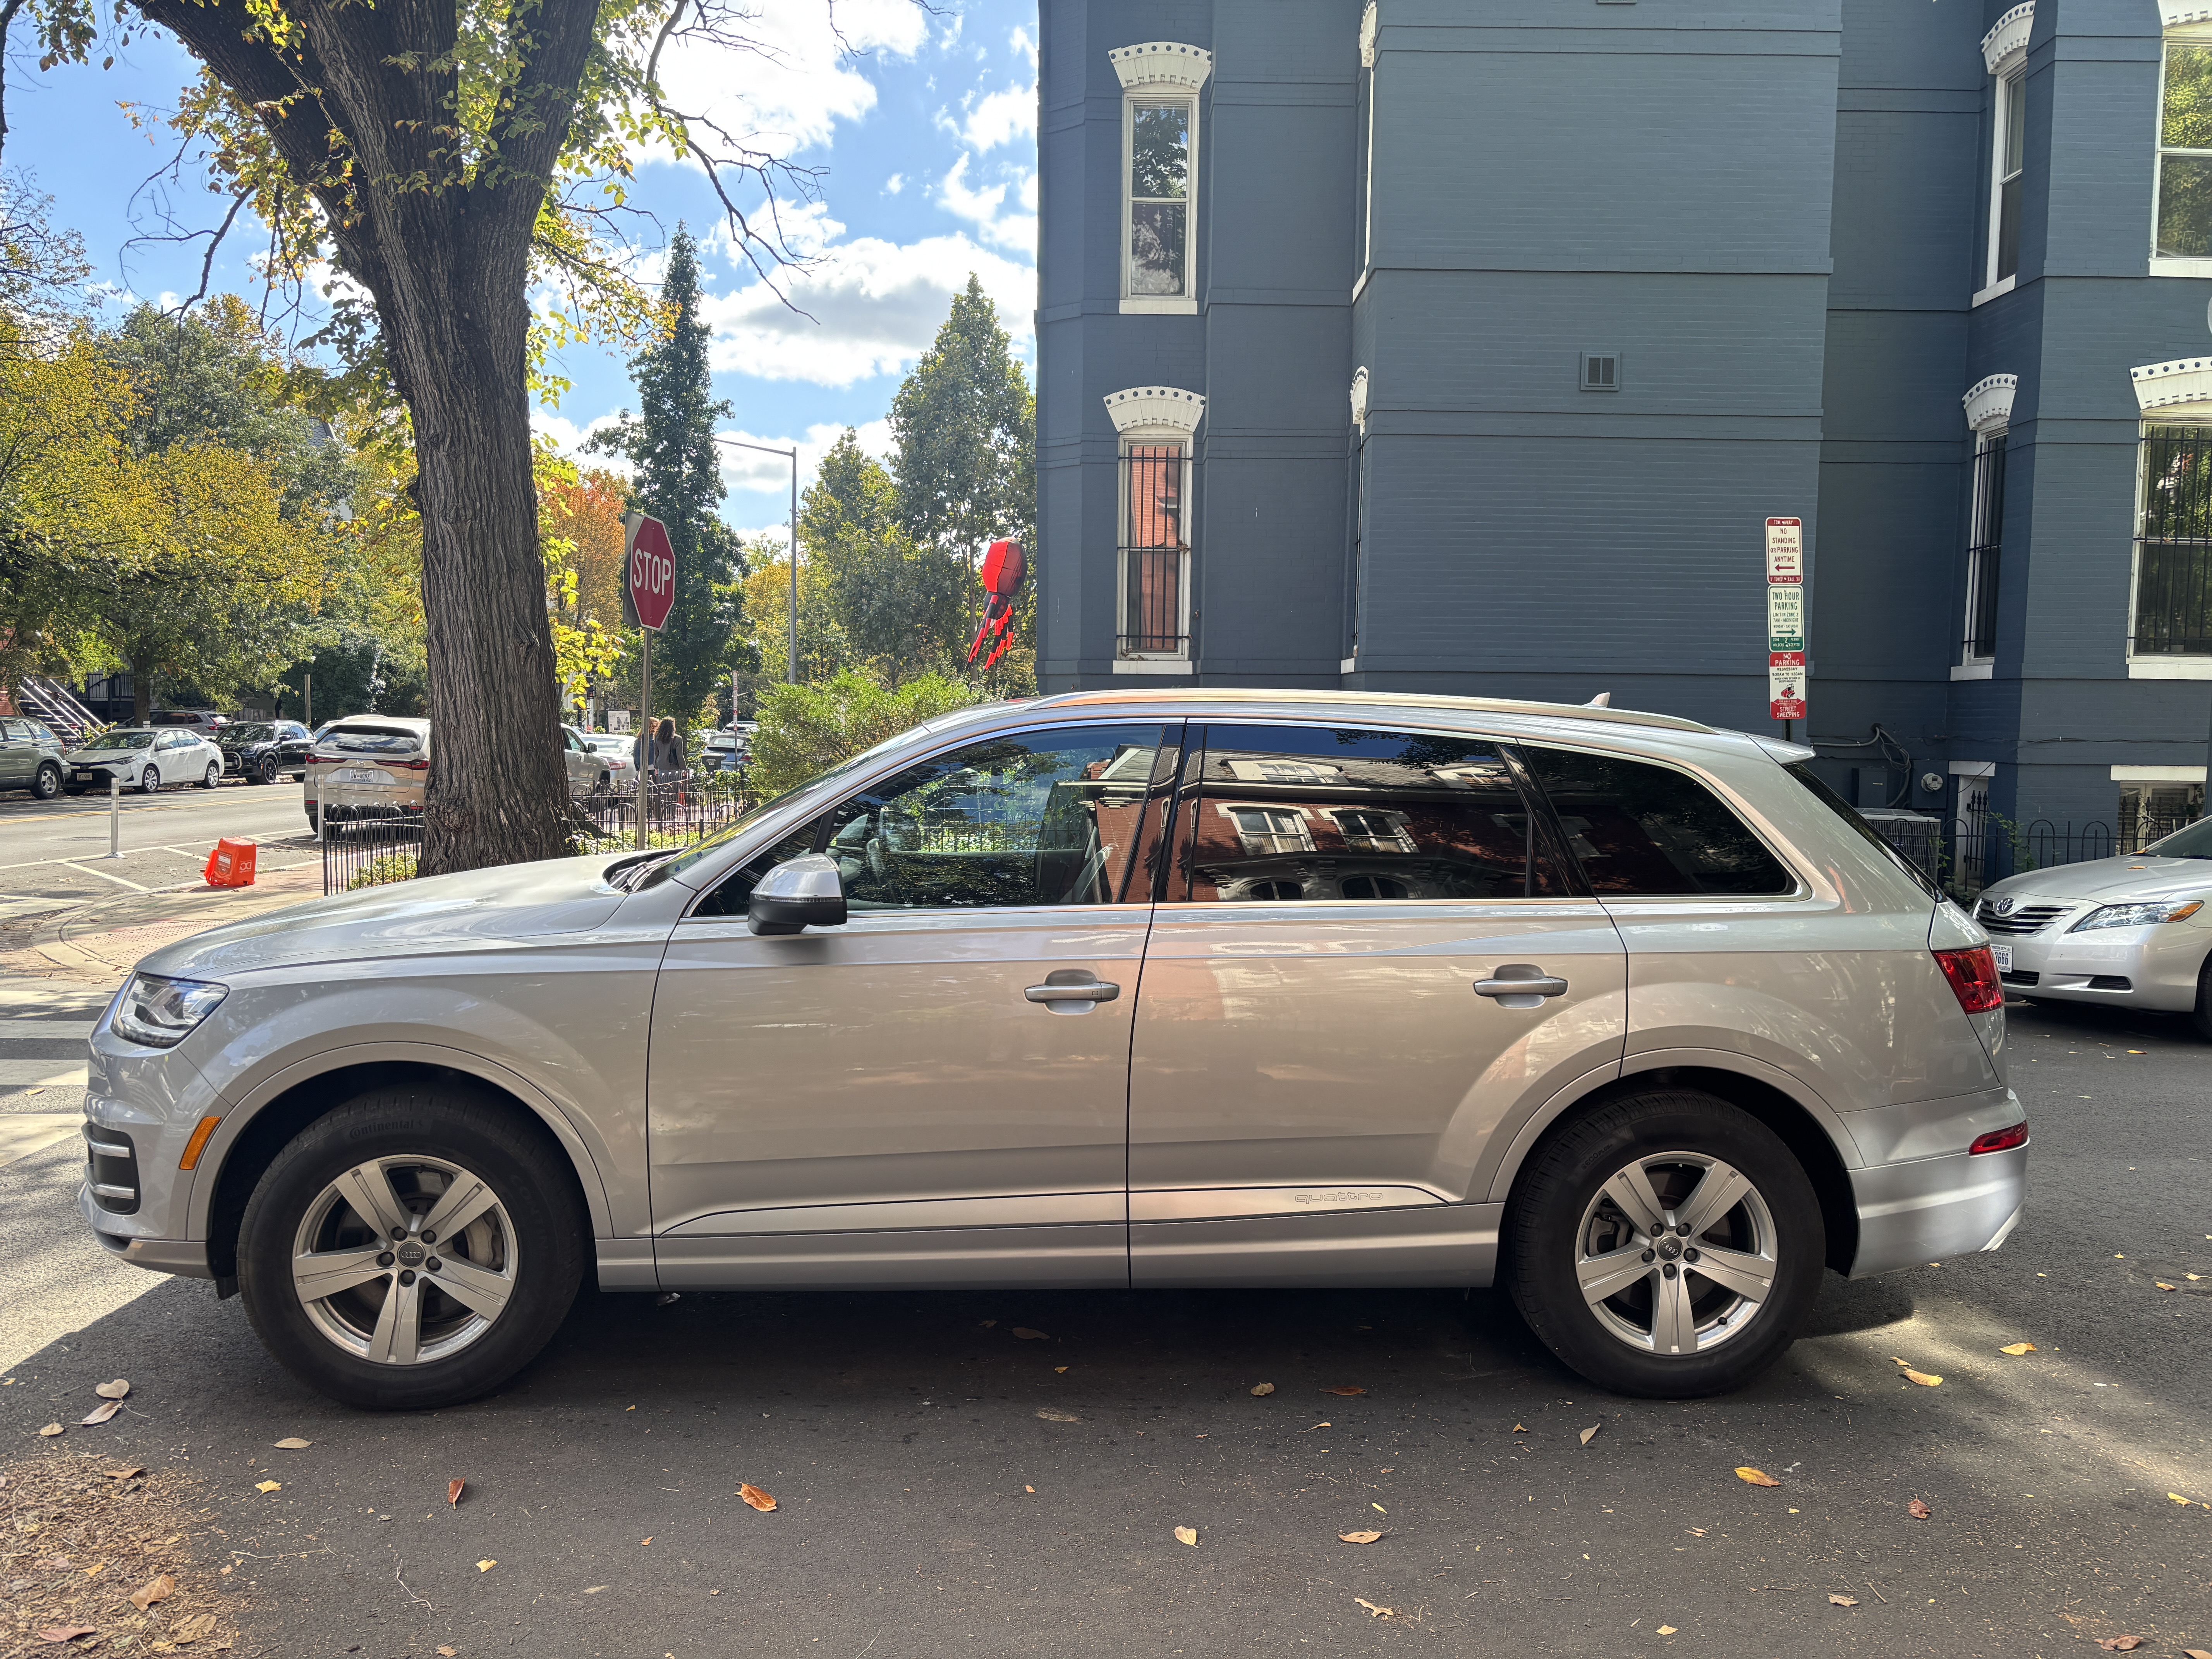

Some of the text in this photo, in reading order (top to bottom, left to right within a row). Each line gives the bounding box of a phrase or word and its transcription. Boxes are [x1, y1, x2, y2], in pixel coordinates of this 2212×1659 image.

[634, 548, 672, 596] STOP
[1772, 592, 1799, 600] TWO HOUR
[1774, 602, 1797, 610] PARKING
[1995, 951, 2008, 965] 3666
[349, 1120, 413, 1140] Continental
[1295, 1192, 1383, 1204] quattro
